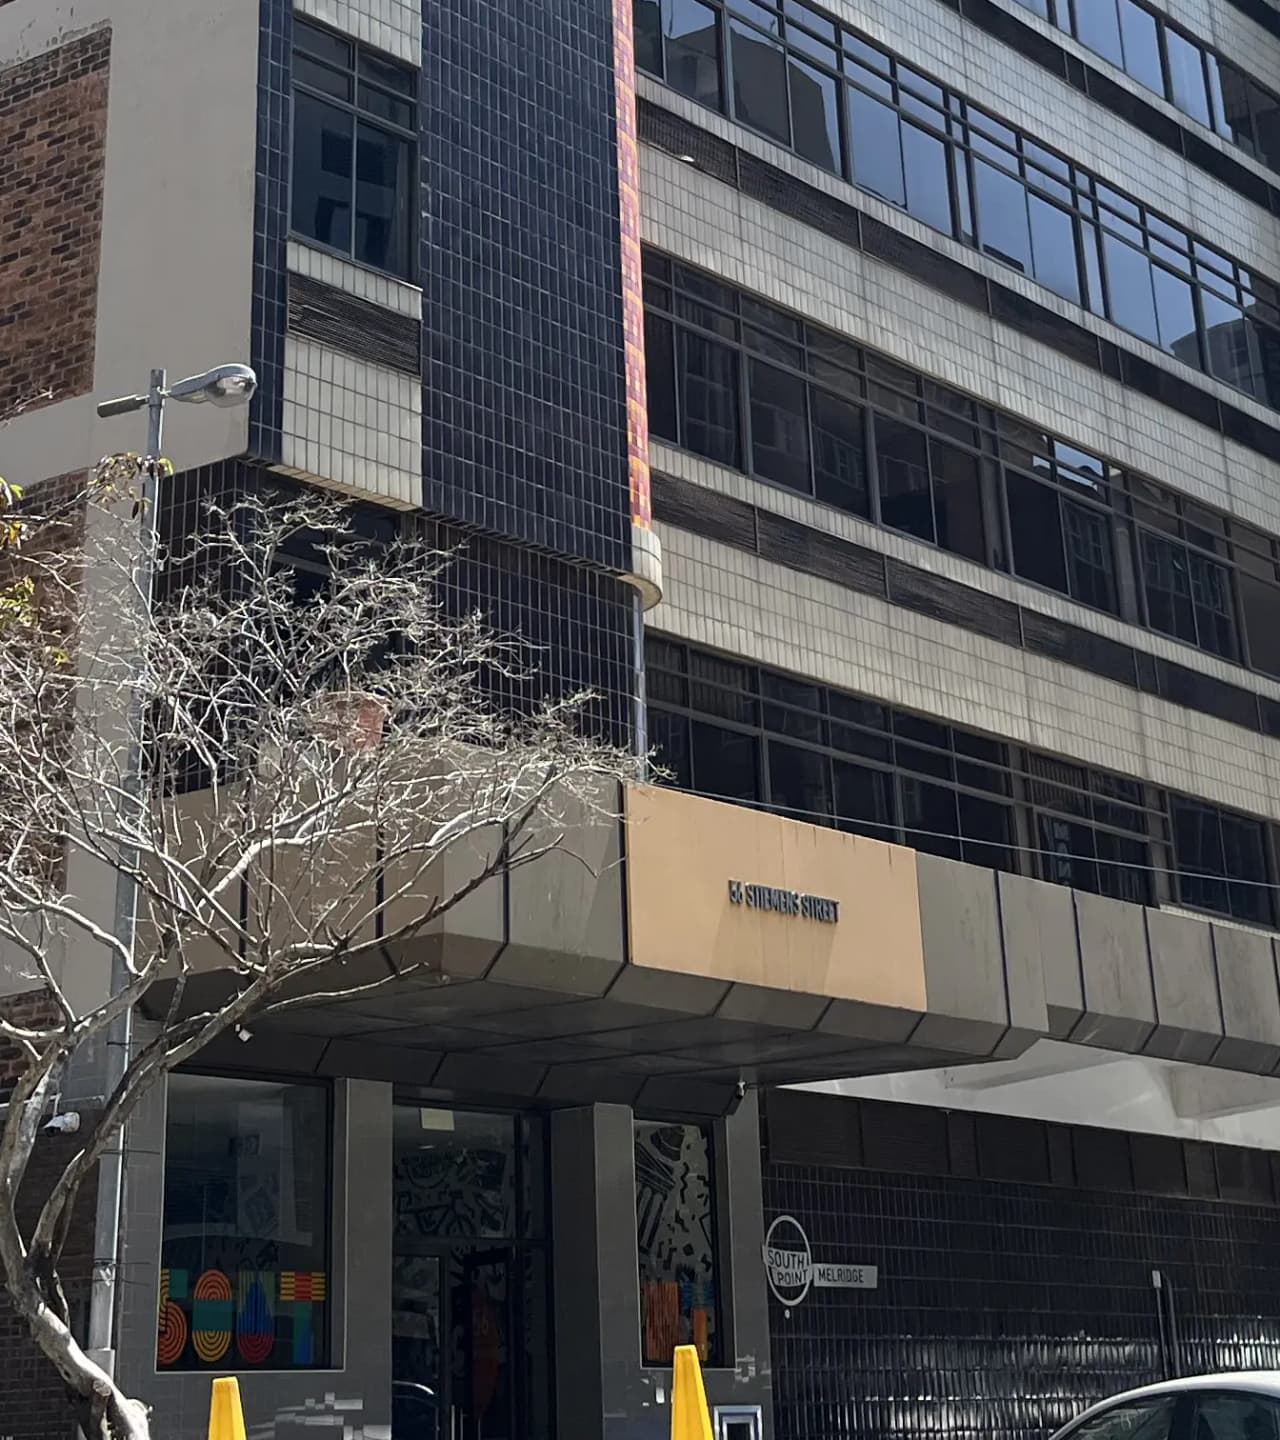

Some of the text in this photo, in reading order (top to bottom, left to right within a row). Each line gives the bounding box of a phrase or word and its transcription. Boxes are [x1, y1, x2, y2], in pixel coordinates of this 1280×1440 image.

[728, 879, 743, 905] 56
[801, 893, 840, 923] STREET
[767, 1249, 806, 1270] SOUTH
[777, 1269, 808, 1285] POINT
[818, 1268, 864, 1283] MELRIDGE
